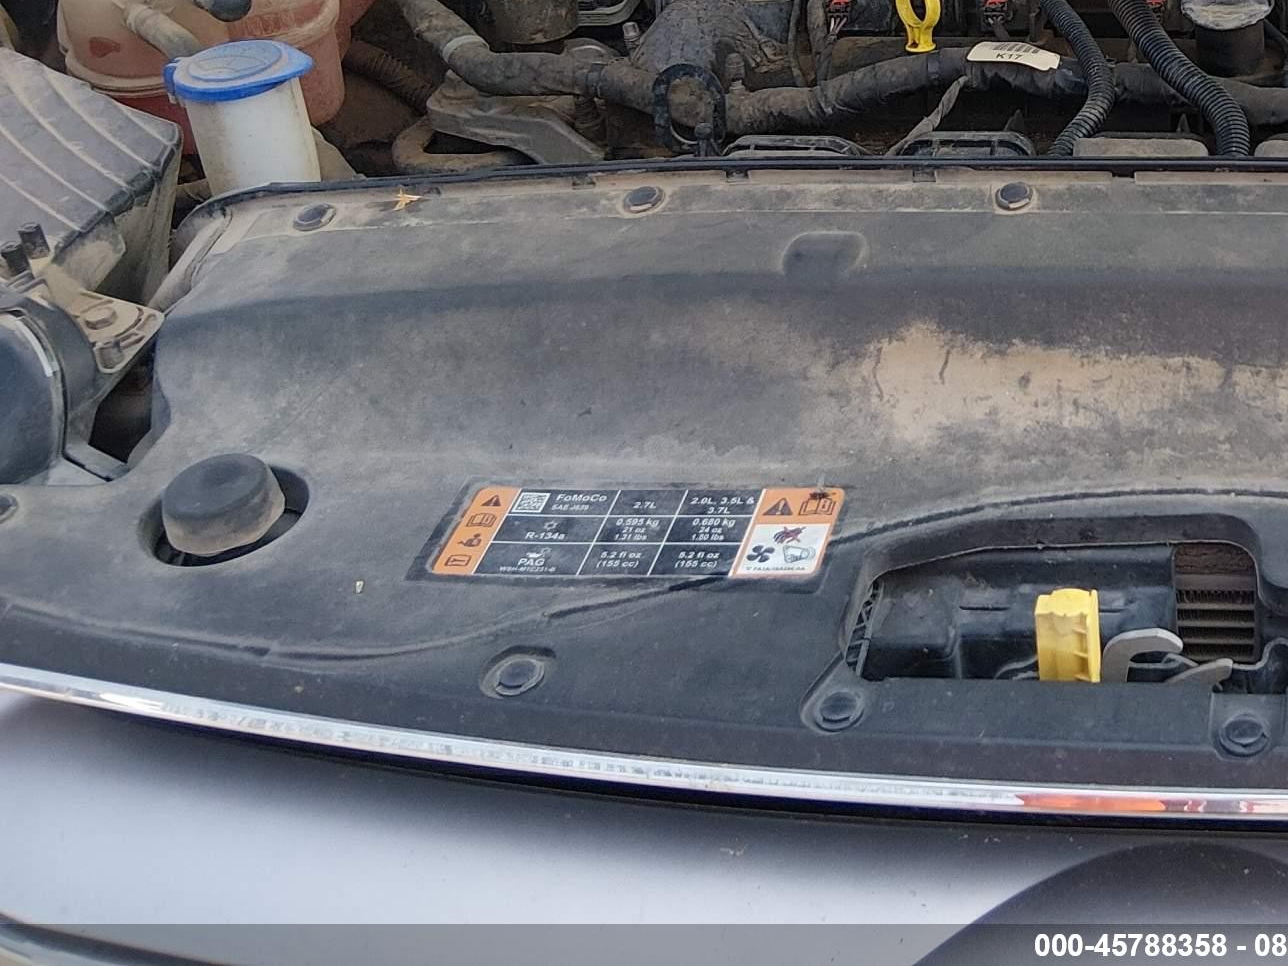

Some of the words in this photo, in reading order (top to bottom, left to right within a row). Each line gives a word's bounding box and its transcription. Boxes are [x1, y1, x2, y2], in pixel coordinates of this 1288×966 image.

[996, 52, 1023, 60] K17
[556, 494, 607, 502] FoMoCo
[720, 497, 744, 505] 3.5L
[746, 496, 755, 505] &
[632, 501, 656, 509] 2.7L
[707, 506, 731, 514] 3.7L
[645, 518, 660, 528] kg
[722, 518, 736, 528] kg
[525, 532, 564, 540] R-134a
[633, 533, 647, 541] lbs
[711, 533, 724, 541] lbs
[517, 558, 545, 566] PAG
[596, 560, 620, 568] (155
[621, 560, 639, 568] cc)
[700, 560, 717, 568] cc)
